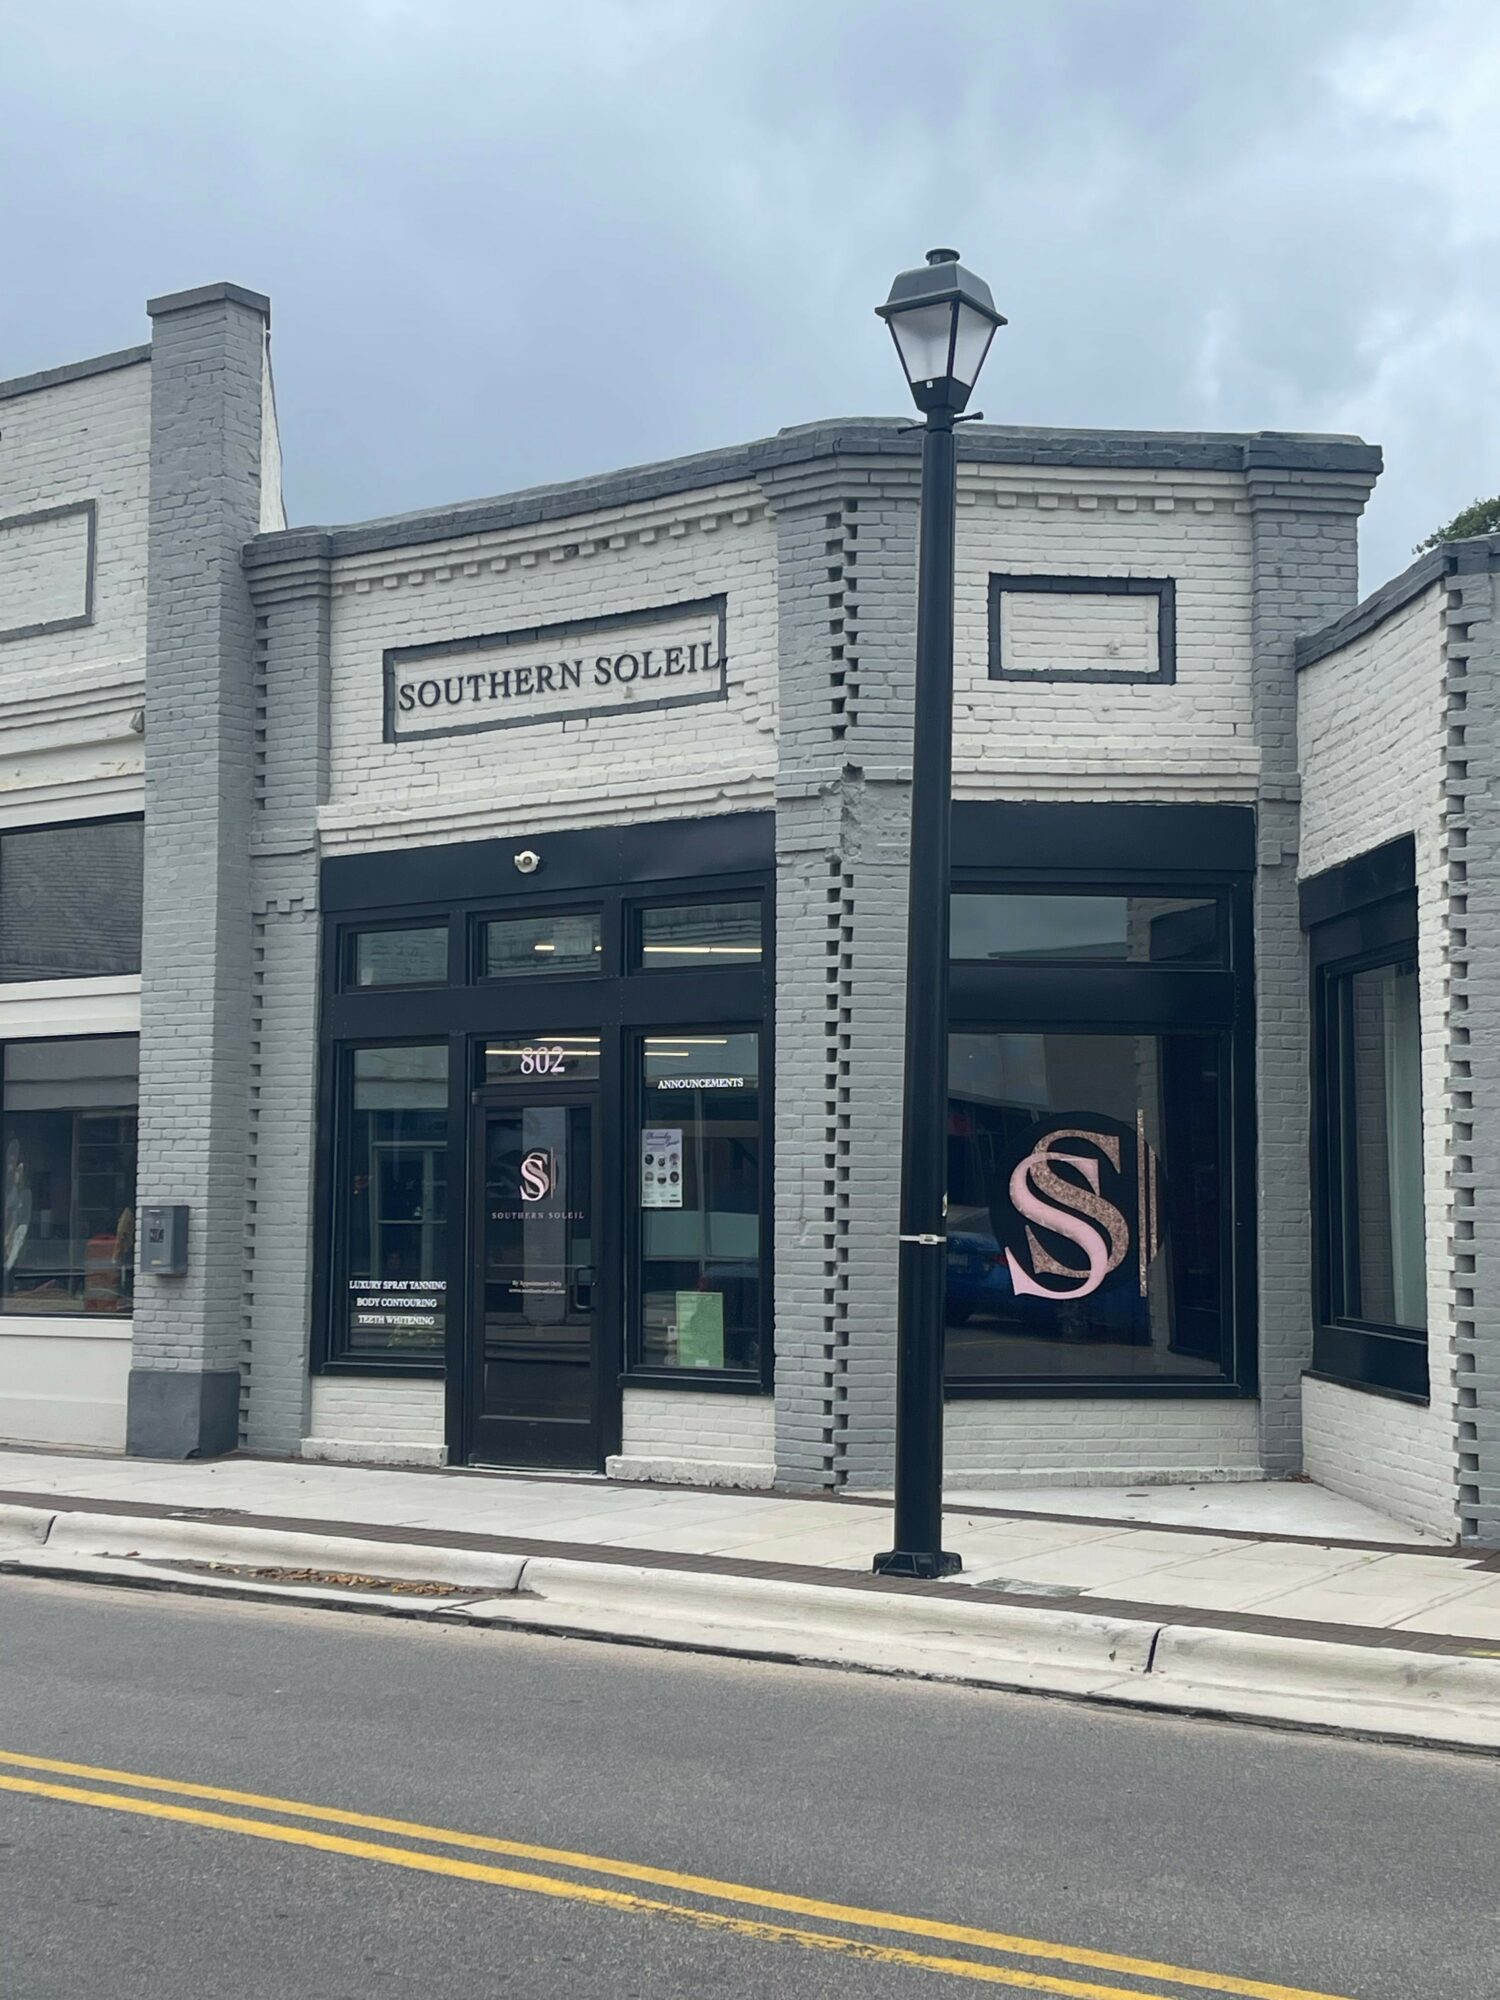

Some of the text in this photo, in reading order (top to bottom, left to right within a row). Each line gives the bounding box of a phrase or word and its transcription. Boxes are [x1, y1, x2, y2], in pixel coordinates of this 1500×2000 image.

[398, 641, 724, 711] SOUTHERN SOLEIL
[520, 1046, 565, 1075] 802
[657, 1077, 744, 1090] ANNOUNCEMENTS
[491, 1211, 585, 1220] SOUTHERN SOLEIL
[349, 1280, 447, 1291] LUXURY SPRAY TANNING
[356, 1297, 437, 1308] BODY CONTOURING
[358, 1314, 435, 1326] TEETH WHITENING
